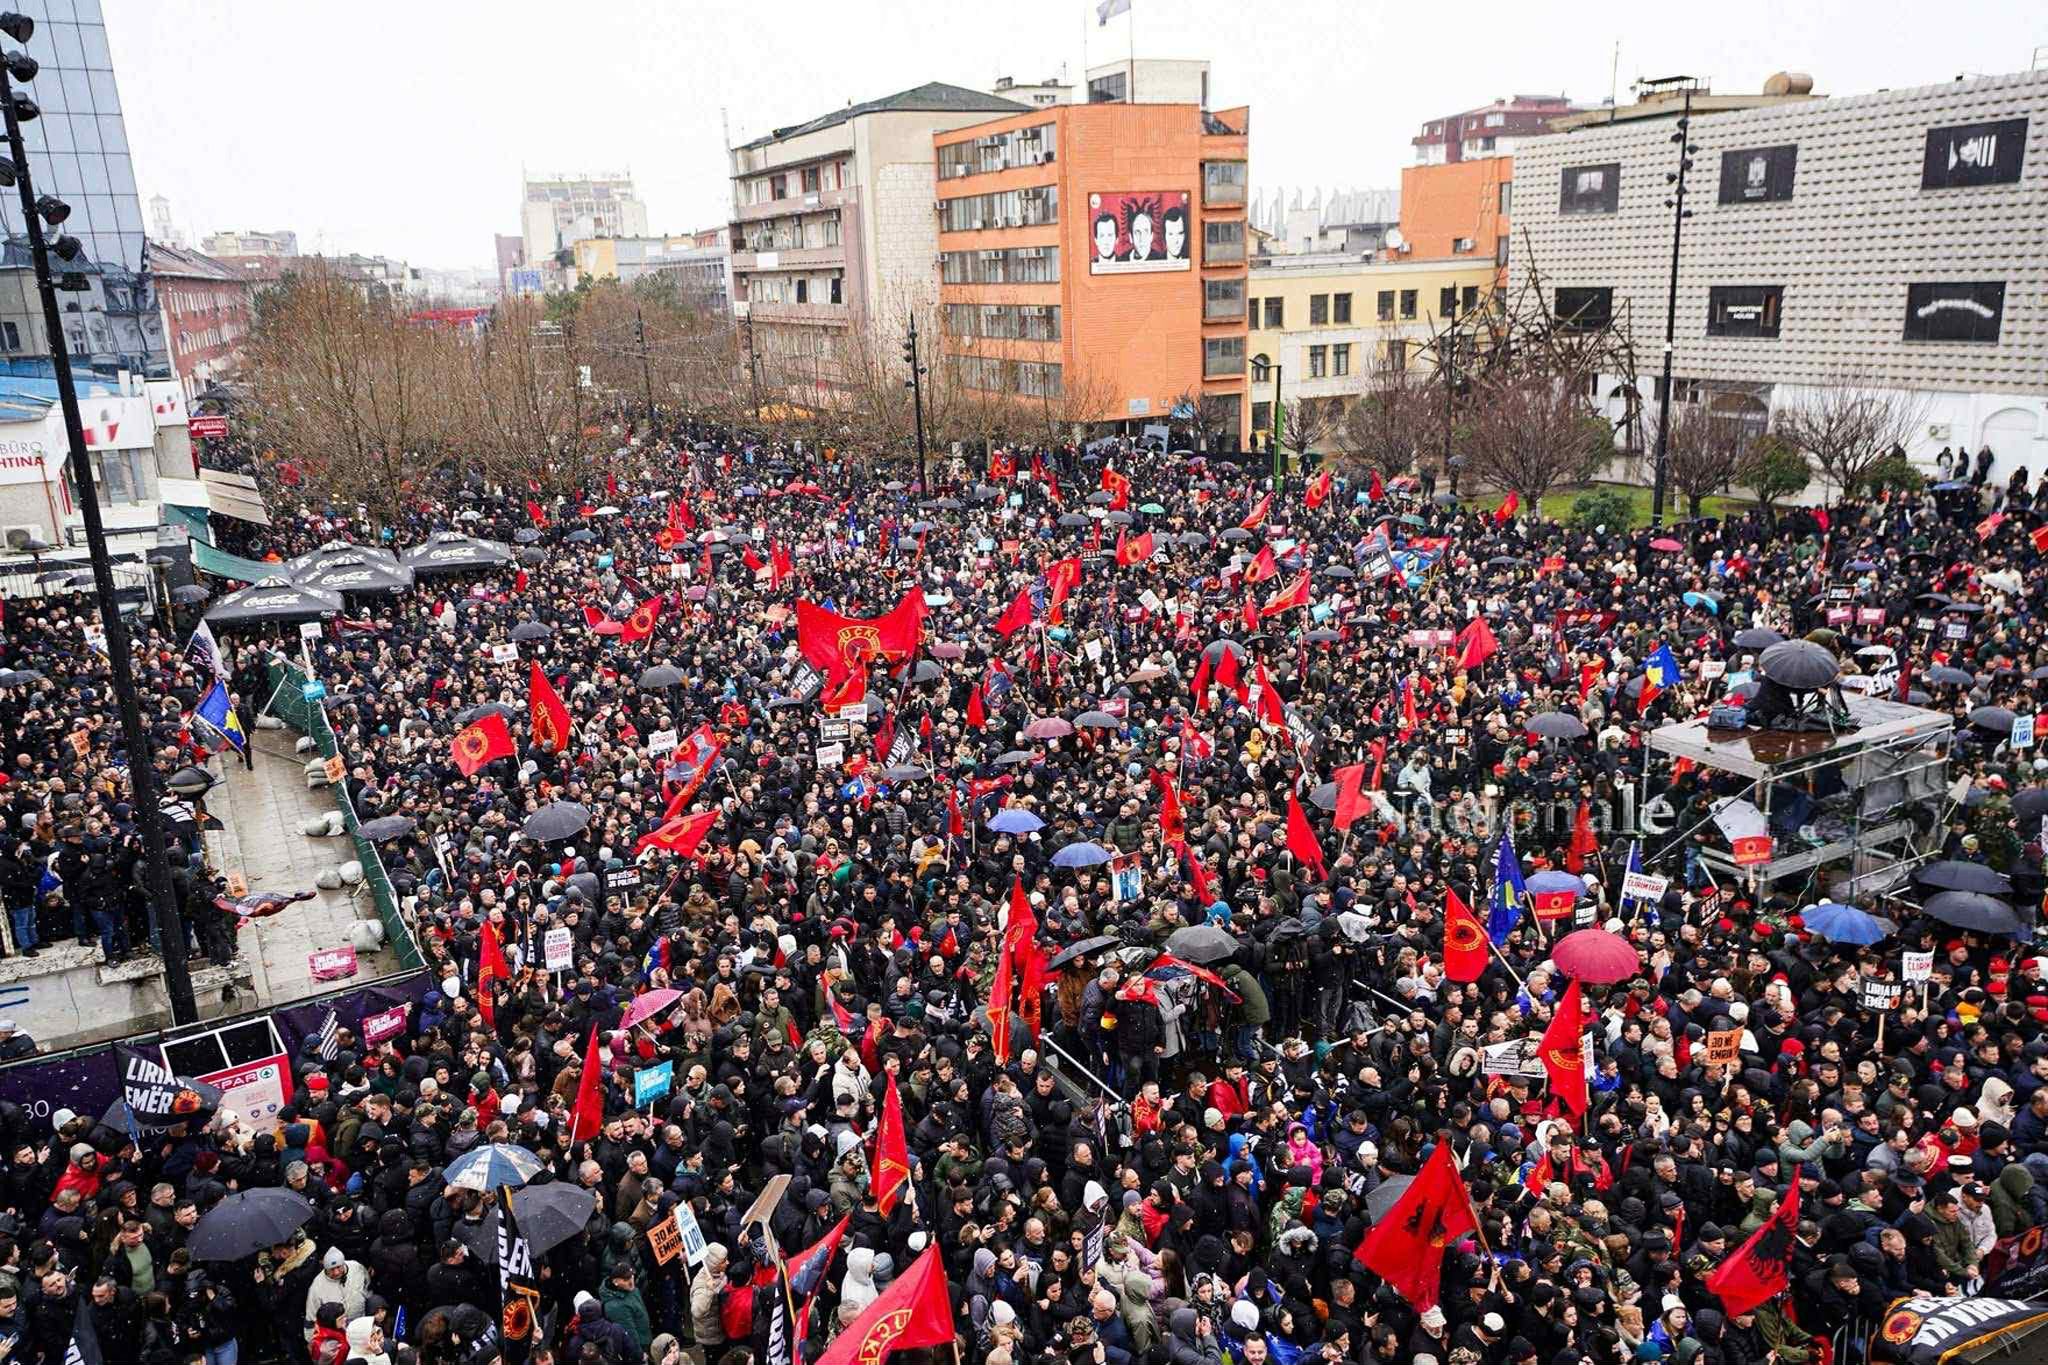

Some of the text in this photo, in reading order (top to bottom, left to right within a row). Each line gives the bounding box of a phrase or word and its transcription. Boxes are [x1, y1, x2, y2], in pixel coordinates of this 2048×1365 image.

[430, 546, 476, 560] Coca-Cola
[320, 570, 374, 585] Coca-Cola
[243, 593, 302, 608] Coca-Cola
[127, 1057, 177, 1088] LIRIA
[126, 1086, 174, 1115] EMËR
[684, 1225, 704, 1257] LIRI
